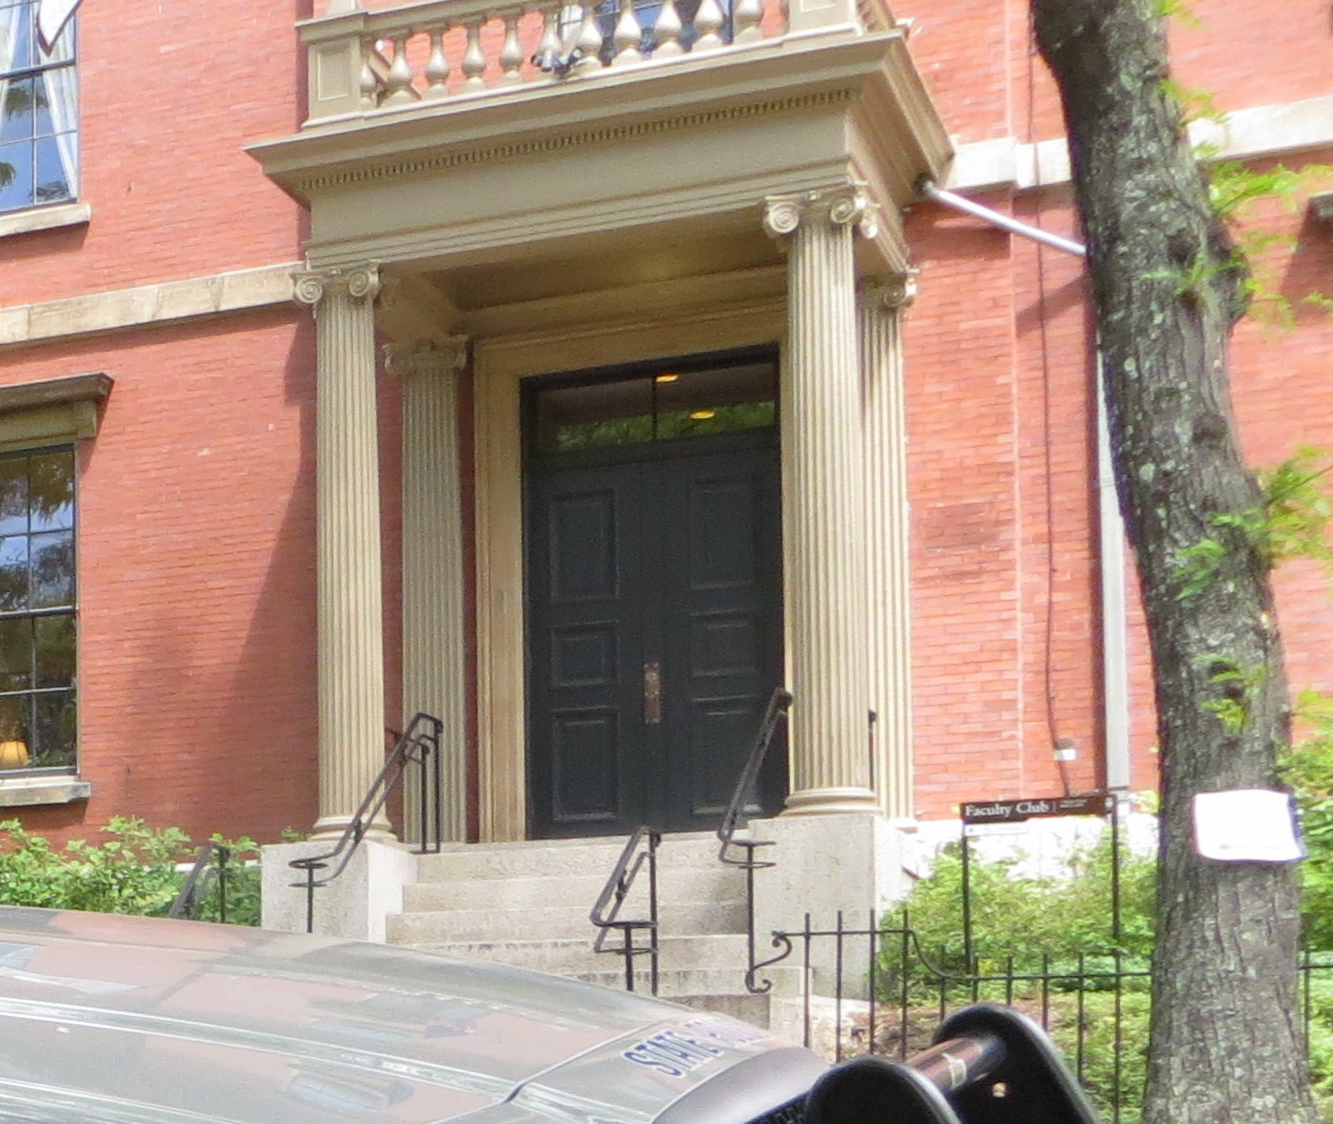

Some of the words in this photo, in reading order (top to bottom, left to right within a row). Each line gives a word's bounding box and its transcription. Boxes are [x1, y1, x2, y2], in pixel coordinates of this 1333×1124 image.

[965, 804, 1013, 818] Faculty
[1016, 801, 1049, 815] Club
[623, 1029, 724, 1078] STATE
